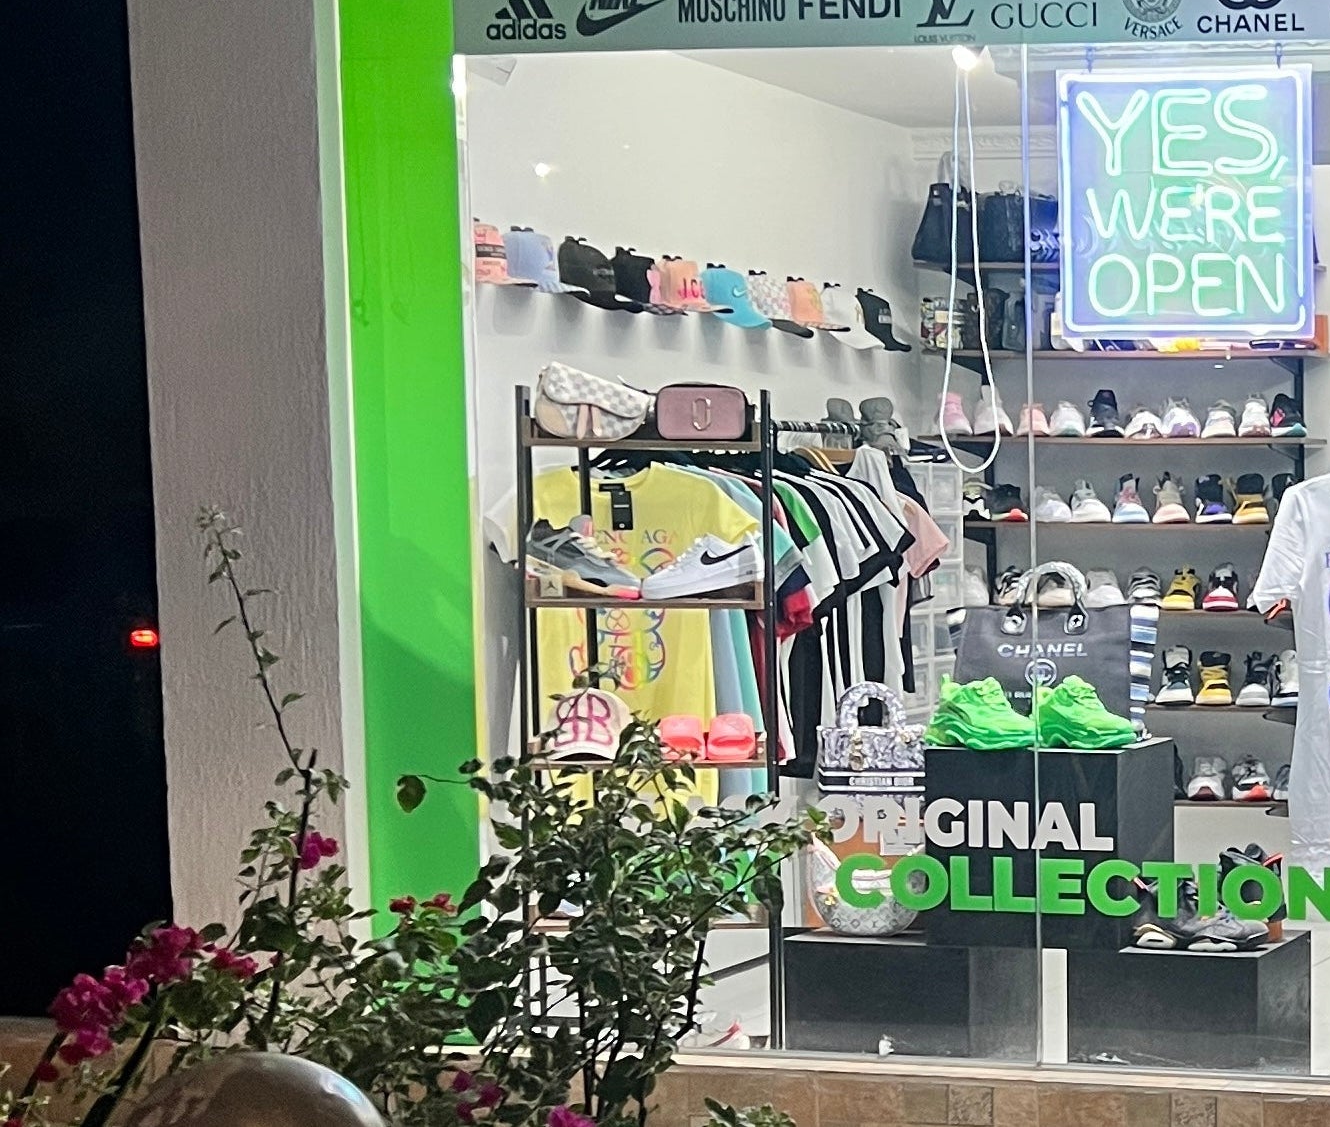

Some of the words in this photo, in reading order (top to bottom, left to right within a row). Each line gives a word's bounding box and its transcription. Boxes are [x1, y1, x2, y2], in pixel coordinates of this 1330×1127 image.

[990, 2, 1097, 29] GUCCI
[1124, 15, 1183, 40] VERSACE
[1197, 13, 1305, 34] CHANEL
[486, 18, 567, 40] adidas
[1088, 252, 1286, 317] OPEN
[997, 643, 1088, 658] CHANEL
[815, 794, 1113, 851] ORIGINAL
